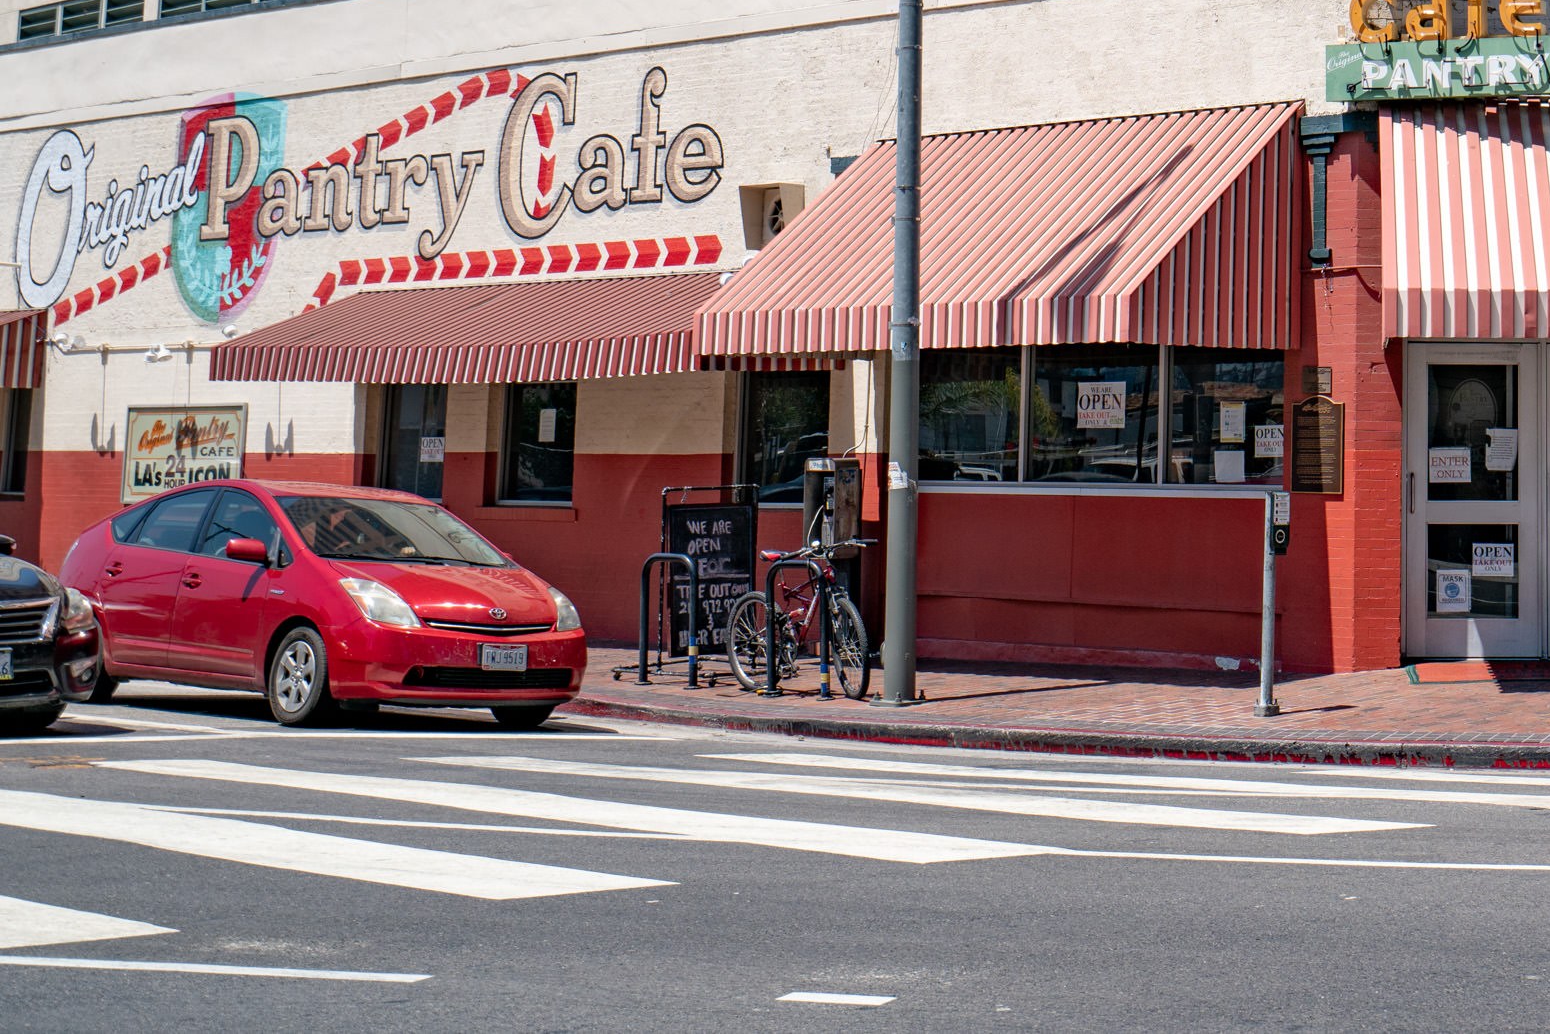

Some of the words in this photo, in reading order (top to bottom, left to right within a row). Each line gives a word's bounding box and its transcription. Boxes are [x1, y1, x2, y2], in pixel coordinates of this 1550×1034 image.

[1362, 53, 1550, 92] PANTRY
[15, 129, 205, 308] Original
[200, 115, 485, 261] Pantry
[499, 66, 724, 240] Cafe
[1079, 394, 1122, 411] OPEN
[1079, 412, 1095, 420] TAKE
[1256, 428, 1284, 439] OPEN
[422, 438, 443, 448] OPEN
[200, 446, 235, 457] CAFE
[165, 455, 186, 477] 24
[1431, 457, 1469, 466] ENTER
[134, 461, 162, 486] LA's
[188, 462, 231, 483] ICON
[1436, 470, 1464, 478] ONLY
[164, 479, 185, 489] HOUR
[686, 519, 707, 534] WE
[712, 520, 732, 534] ARE
[688, 538, 721, 554] OPEN
[1474, 547, 1512, 557] OPEN
[676, 584, 705, 599] TE
[709, 583, 731, 597] OUT
[702, 599, 722, 615] 972
[678, 630, 709, 647] UR
